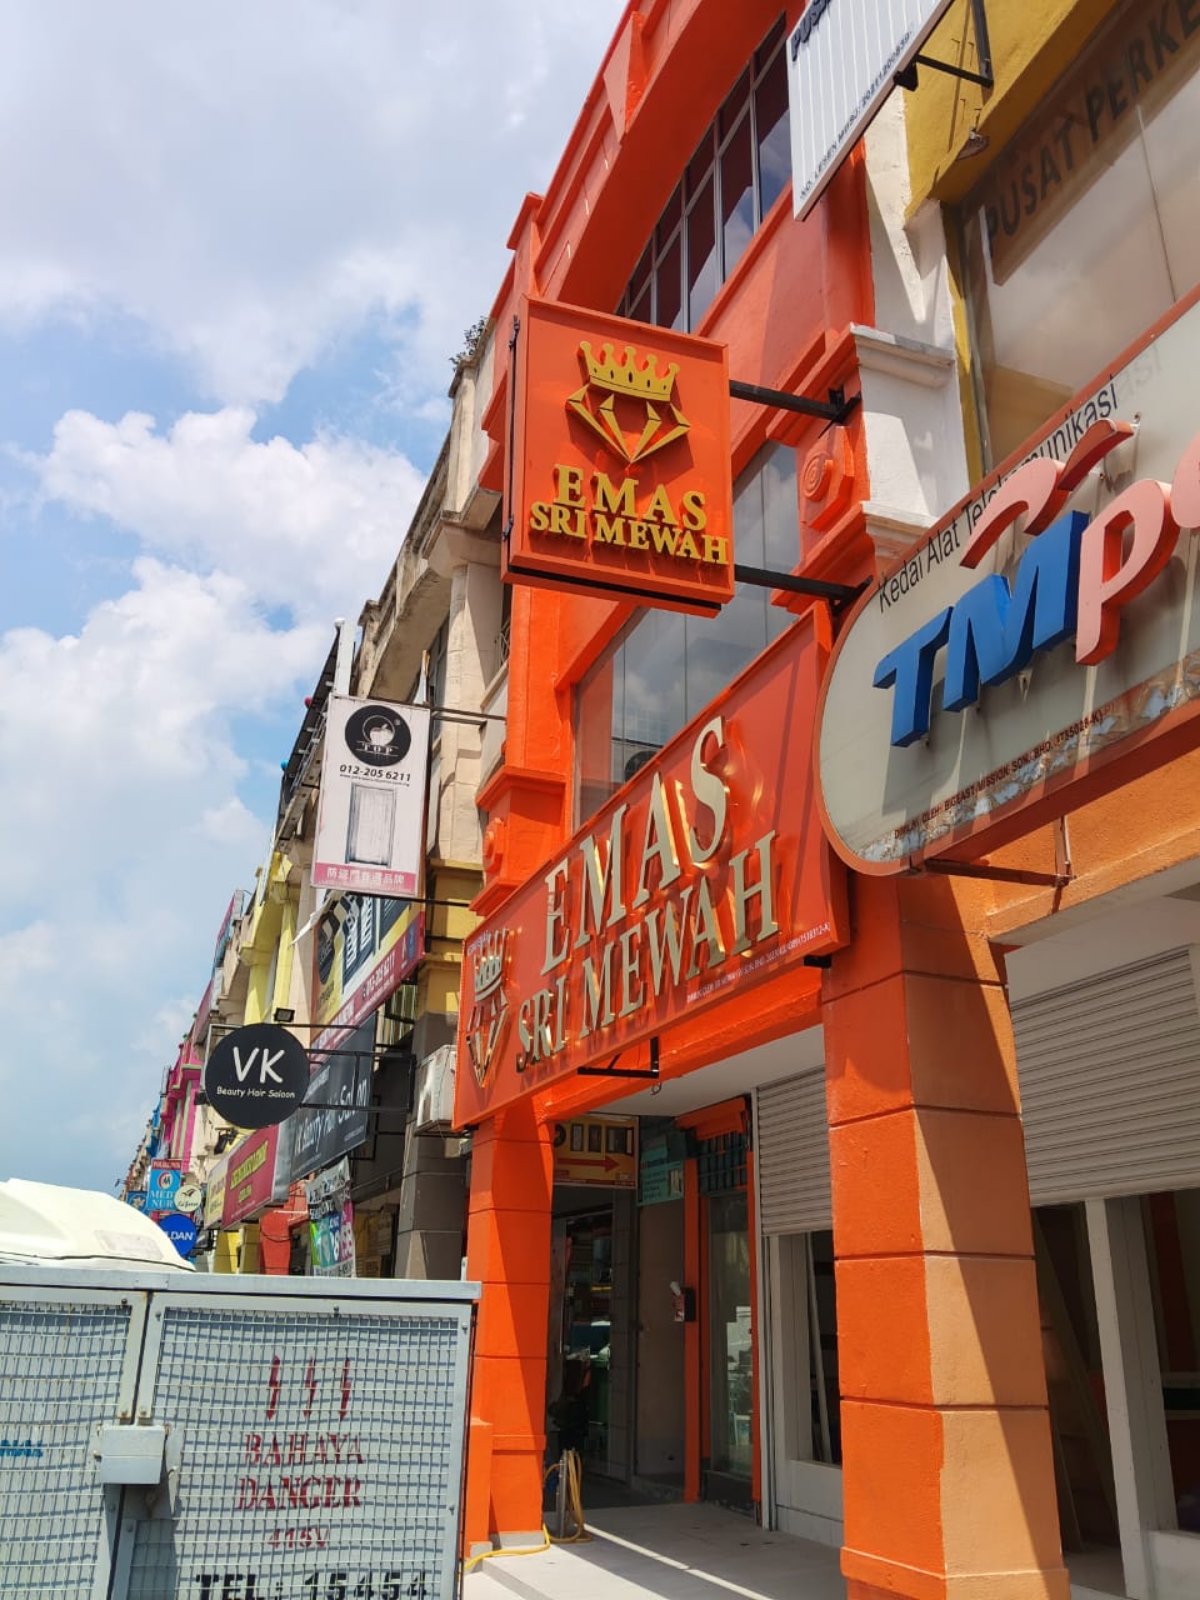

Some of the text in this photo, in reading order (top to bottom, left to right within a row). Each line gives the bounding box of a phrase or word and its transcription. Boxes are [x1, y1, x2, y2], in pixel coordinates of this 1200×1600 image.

[791, 0, 832, 61] PUS
[985, 112, 1076, 258] PUSAT
[553, 464, 707, 531] EMAS
[529, 501, 729, 566] SRI MEWAH
[878, 549, 923, 613] Kedai
[926, 520, 961, 574] Alat
[339, 764, 384, 778] 012-205
[385, 770, 412, 782] 6211
[541, 716, 728, 976] EMAS
[516, 976, 568, 1073] SRI
[579, 829, 780, 1039] MEWAH
[233, 1046, 285, 1084] VK
[216, 1086, 296, 1099] Beauty Hair Saloon
[244, 1433, 364, 1466] BAHAYA
[236, 1477, 362, 1510] DANGER
[267, 1528, 331, 1549] 415V
[304, 1571, 427, 1600] 15454
